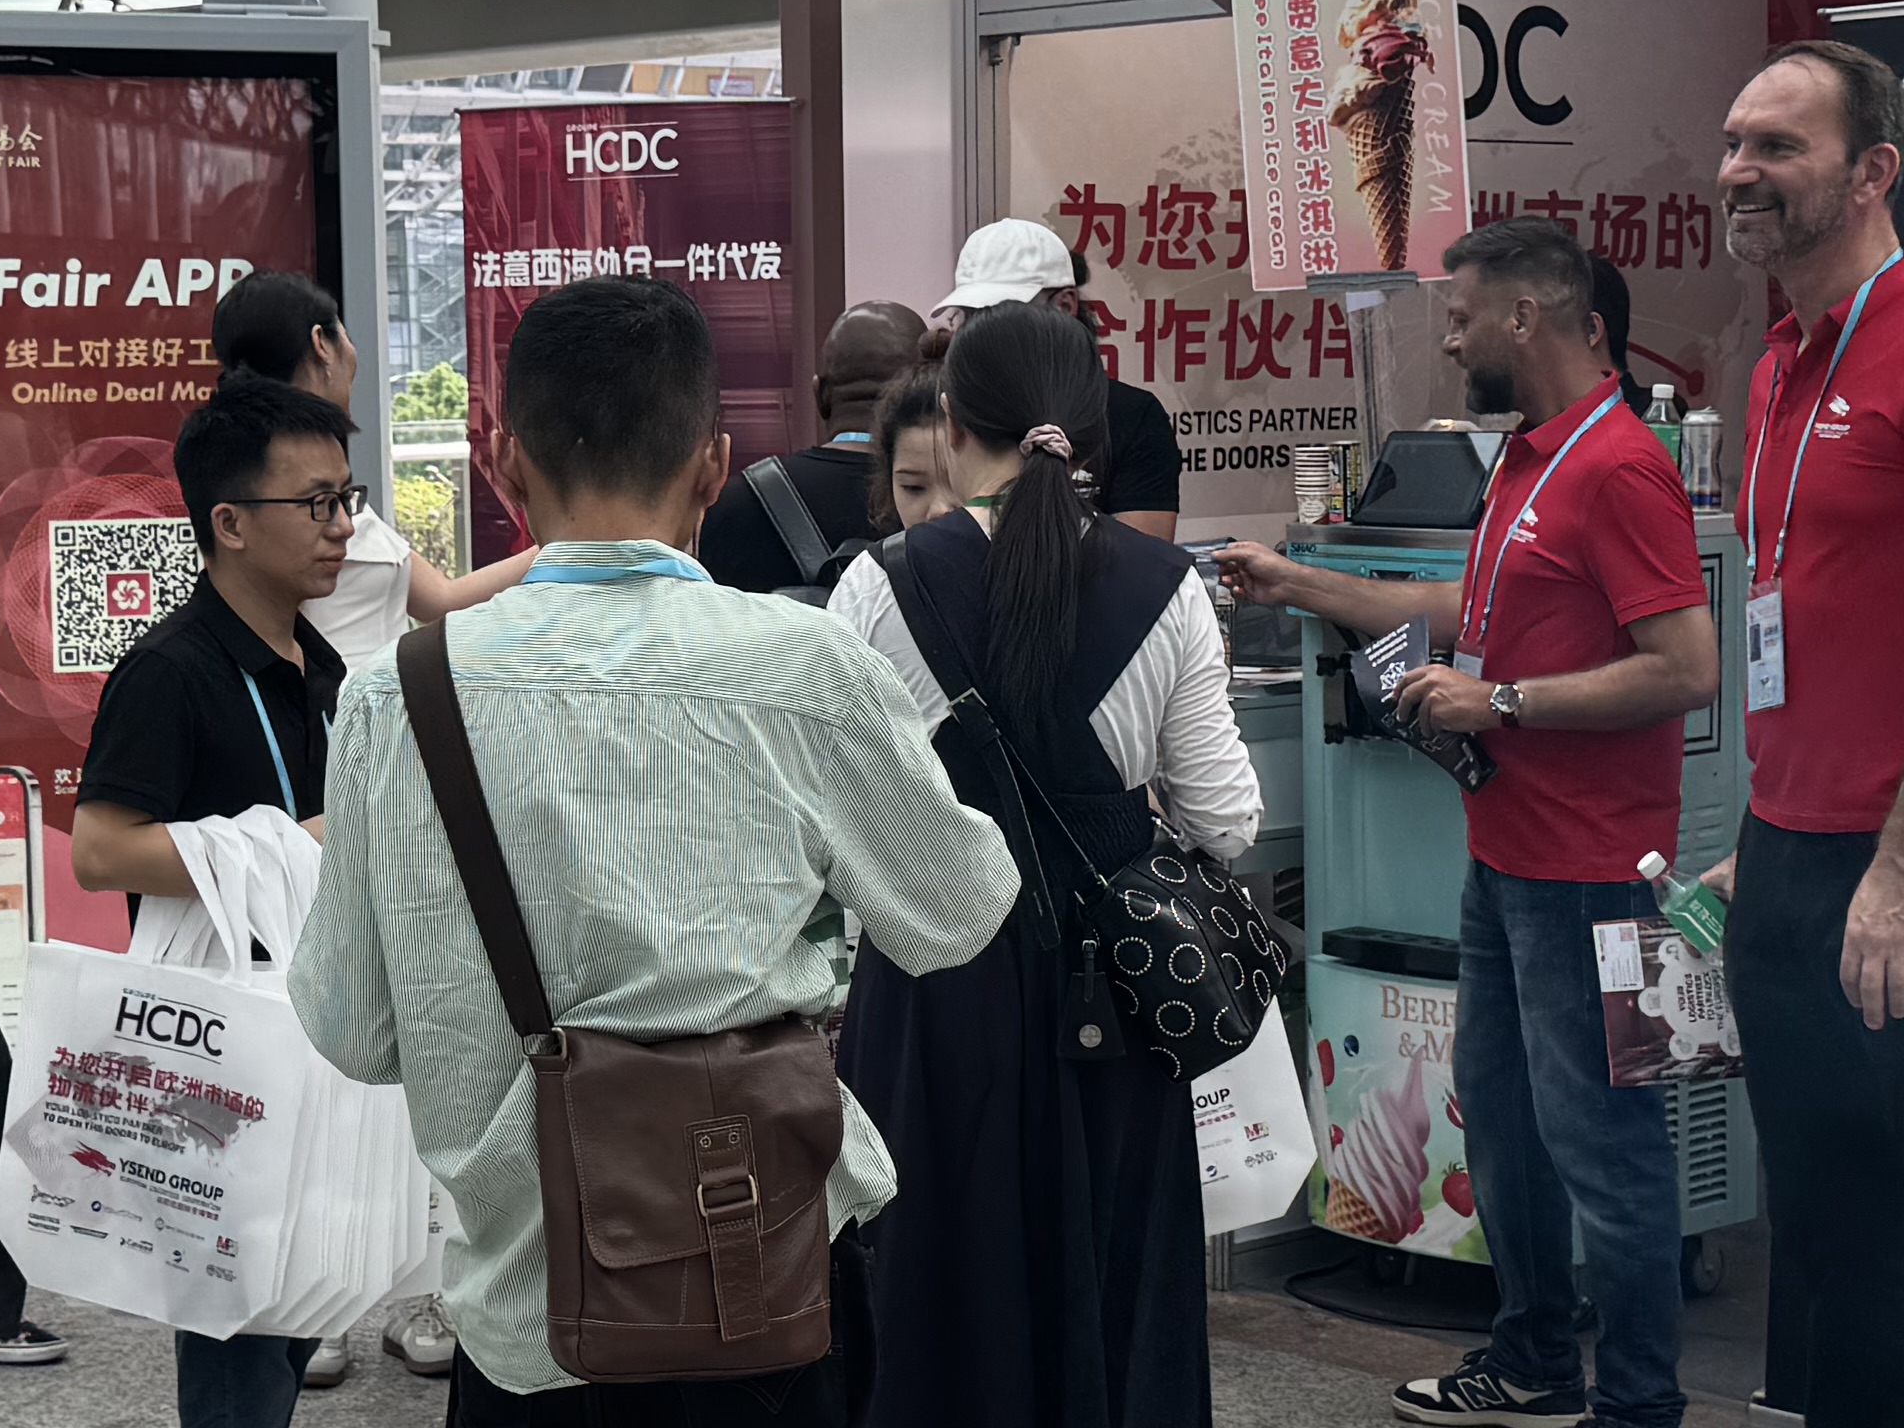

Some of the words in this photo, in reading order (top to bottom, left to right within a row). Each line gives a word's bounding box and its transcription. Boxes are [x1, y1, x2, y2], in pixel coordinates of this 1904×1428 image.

[1458, 3, 1573, 126] DC
[7, 156, 41, 169] FAIR
[565, 128, 679, 175] HCDC
[1264, 139, 1282, 184] Ice
[1422, 82, 1453, 214] CREAM
[1267, 187, 1288, 269] cream
[125, 257, 256, 309] APP
[473, 241, 782, 288] 法意西海外仓一件代发
[11, 381, 99, 405] Online
[106, 380, 164, 403] Deal
[1171, 409, 1242, 435] ISTICS
[1249, 407, 1358, 433] PARTNER
[1180, 447, 1207, 473] HE
[1213, 444, 1290, 471] DOORS
[115, 995, 226, 1057] HCDC
[50, 1046, 265, 1122] 为您开启欧洲市场的
[120, 1157, 166, 1185] YSEND
[169, 1174, 224, 1202] GROUP
